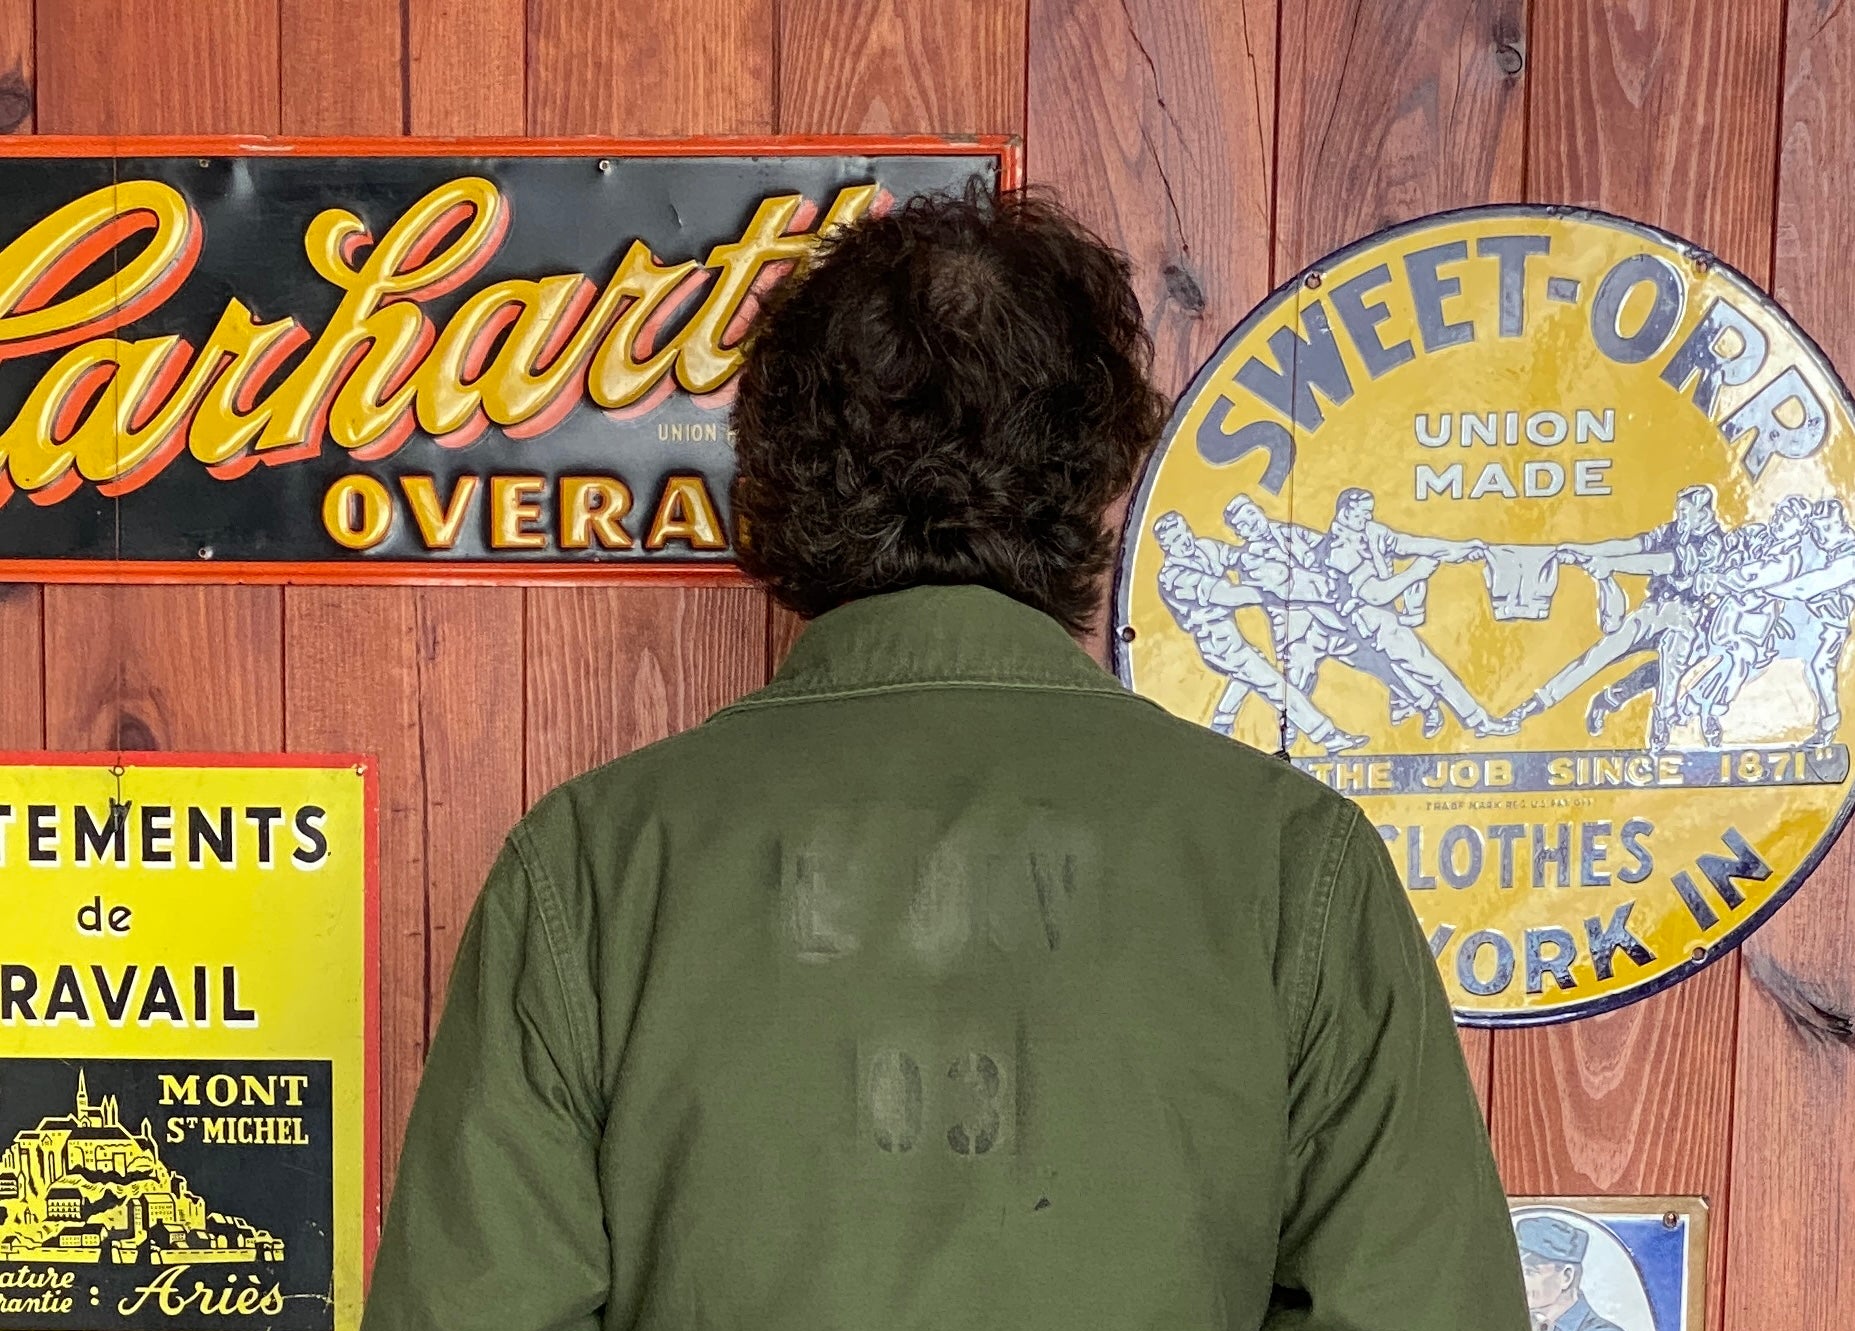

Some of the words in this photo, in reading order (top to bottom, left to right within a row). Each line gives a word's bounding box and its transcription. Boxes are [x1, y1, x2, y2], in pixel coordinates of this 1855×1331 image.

[1194, 235, 1829, 494] SWEET-ORR
[658, 423, 717, 442] UNION
[1414, 409, 1617, 447] UNION
[1413, 459, 1614, 500] MADE
[322, 474, 742, 551] OVERA
[1309, 761, 1394, 790] THE
[1422, 759, 1514, 788] JOB
[1548, 755, 1685, 787] SINCE
[1671, 826, 1774, 934] IN
[77, 895, 133, 933] de
[0, 964, 256, 1022] RAVAIL
[157, 1074, 310, 1108] MONT
[202, 1117, 310, 1146] MICHEL
[0, 1265, 76, 1289] ature
[117, 1264, 285, 1316] Ariès
